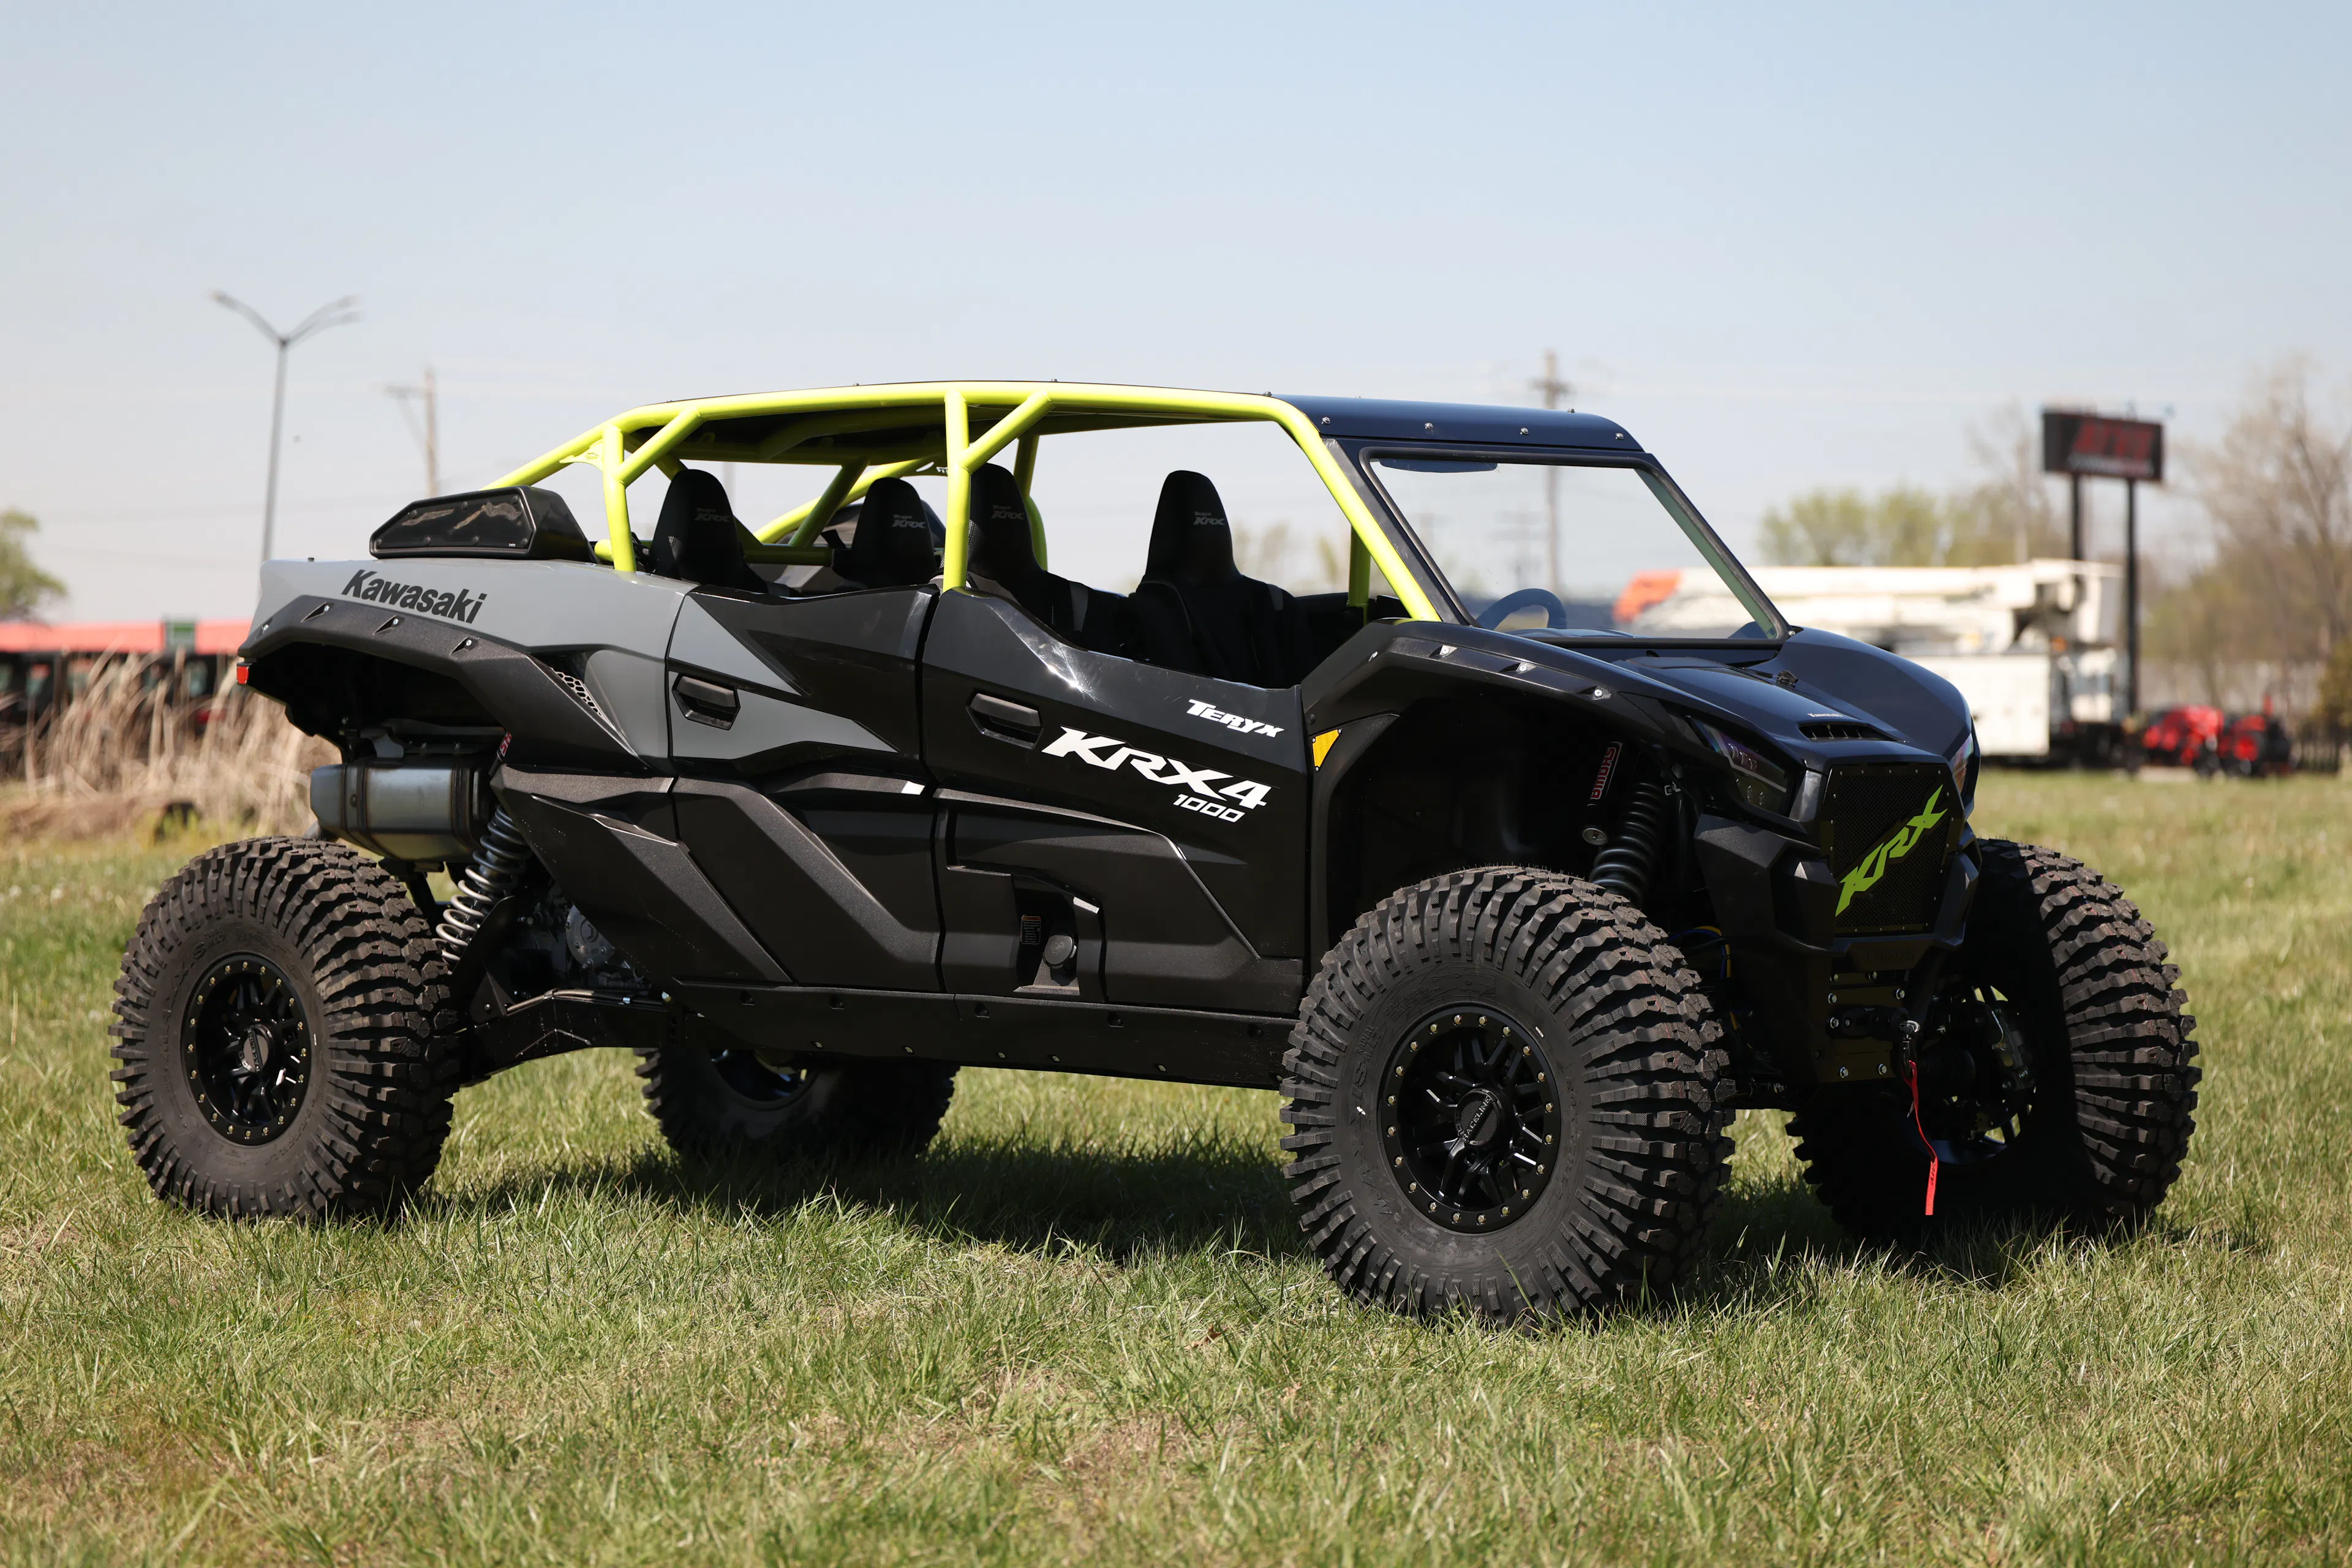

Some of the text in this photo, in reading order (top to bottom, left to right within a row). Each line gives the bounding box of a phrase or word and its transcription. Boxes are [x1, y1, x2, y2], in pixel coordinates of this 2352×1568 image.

[891, 519, 927, 529] KRX
[990, 510, 1025, 519] KRX
[1193, 517, 1226, 526] KRX
[341, 569, 488, 624] Kawasaki
[1186, 699, 1284, 738] TERYX
[1590, 746, 1617, 801] SHOWA
[1173, 793, 1245, 823] 1000
[1835, 784, 1948, 918] KRX
[1355, 1023, 1376, 1056] RADIAL
[1461, 1095, 1492, 1142] RACELINE
